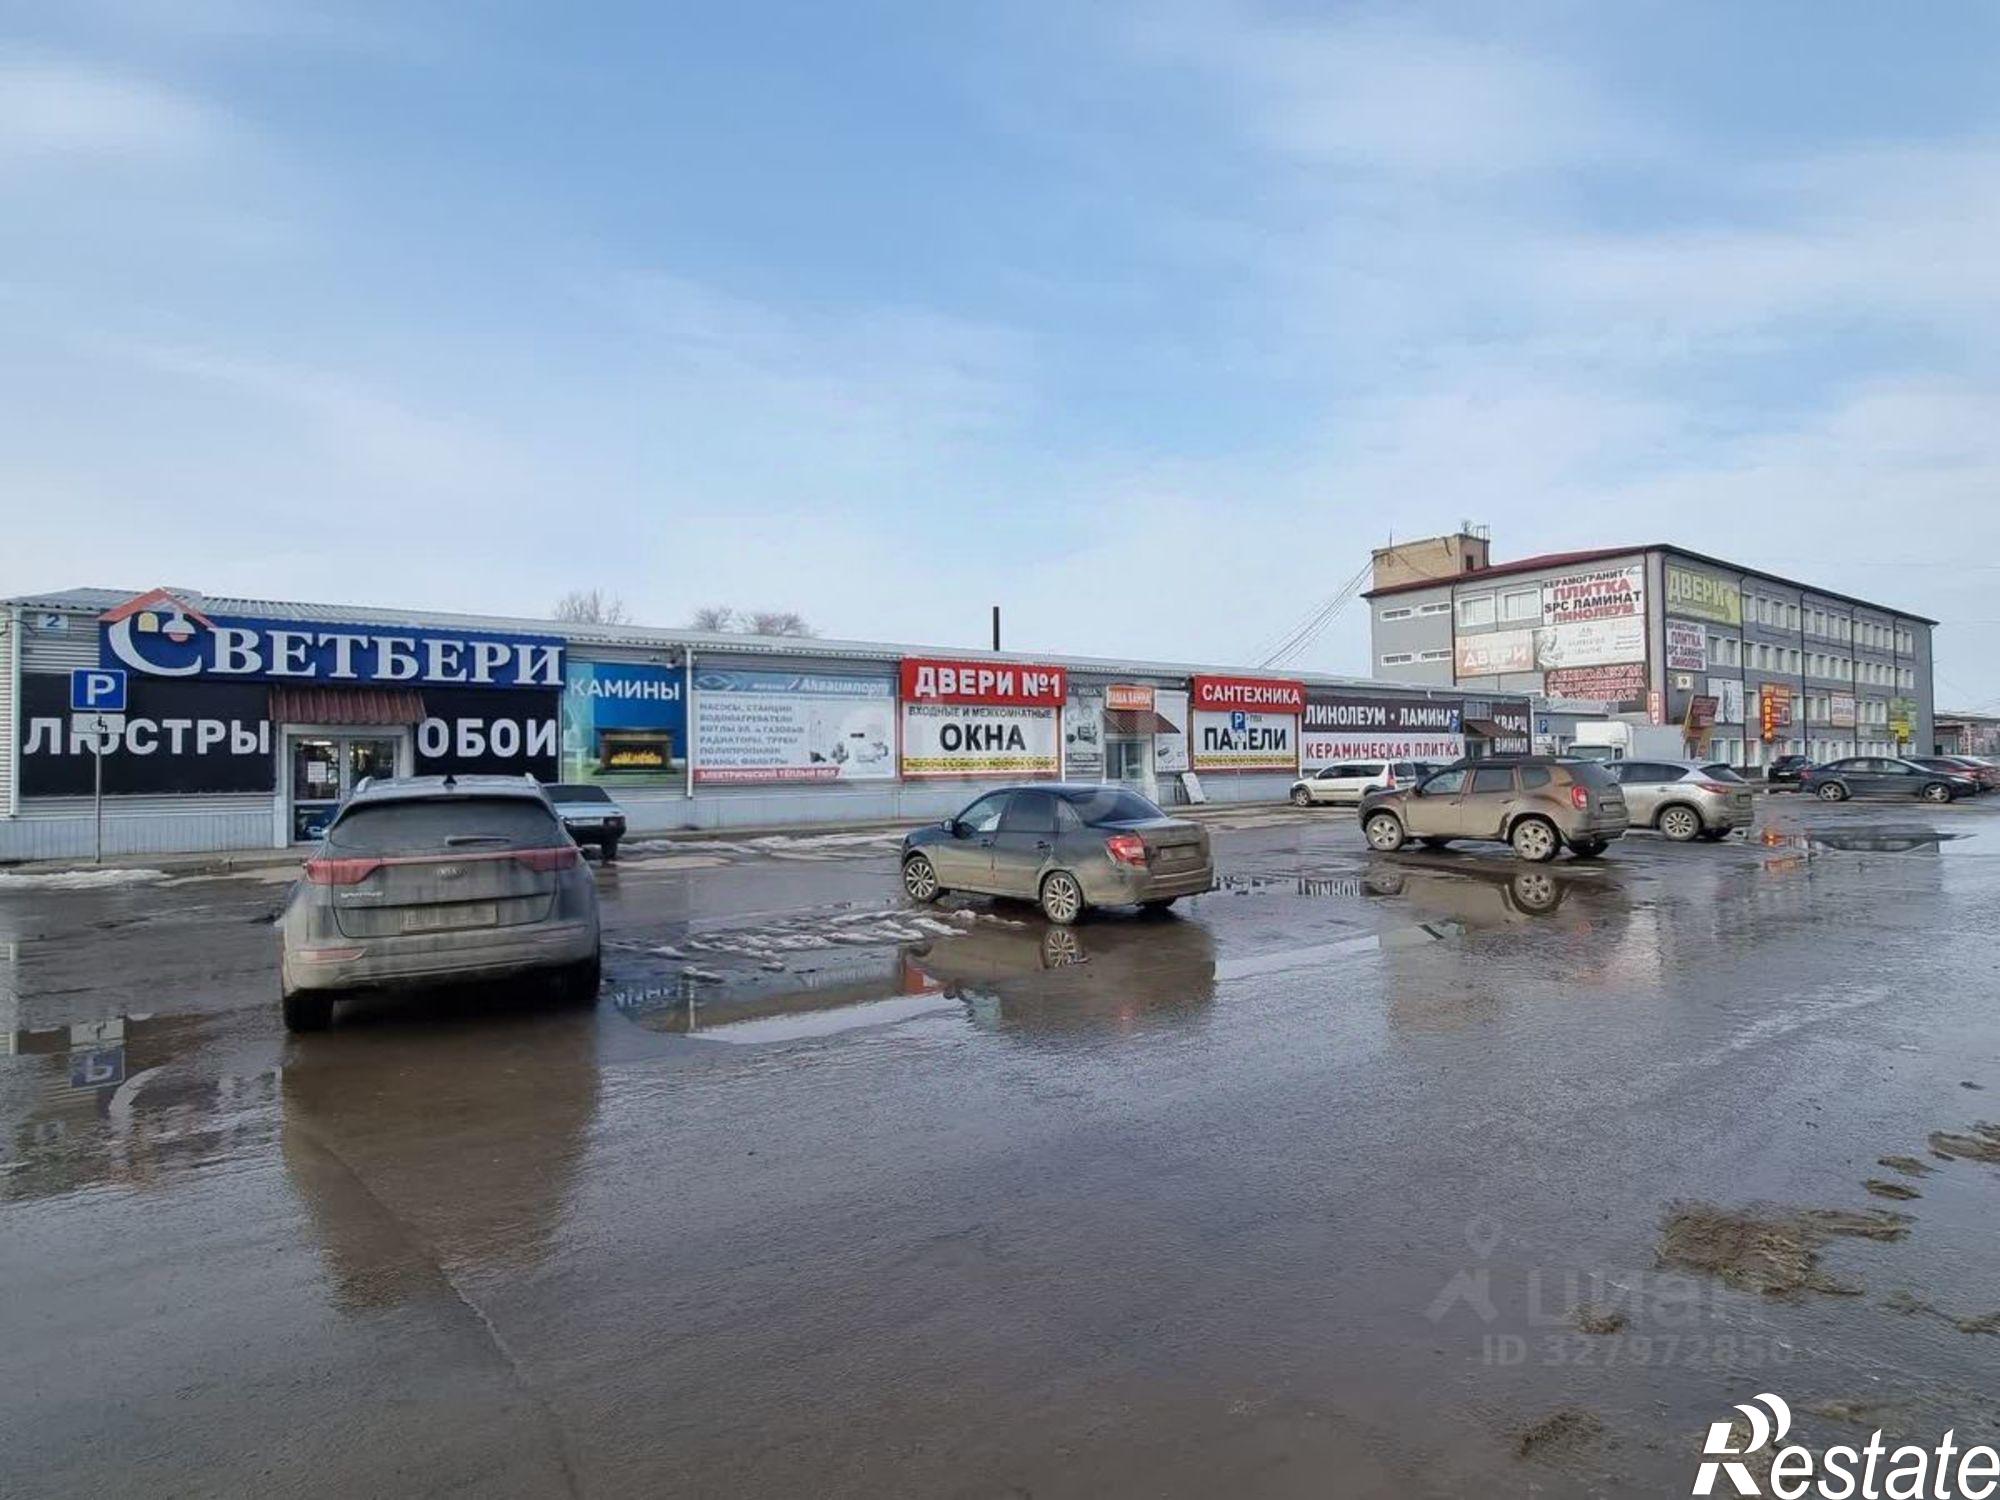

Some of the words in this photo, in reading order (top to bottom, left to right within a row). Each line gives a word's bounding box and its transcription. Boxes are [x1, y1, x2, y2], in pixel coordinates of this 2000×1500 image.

[1553, 578, 1632, 600] ПЛИТКА
[1667, 568, 1725, 607] ДВЕРИ
[1544, 600, 1569, 614] SPC
[1573, 590, 1642, 610] ЛАМИНАТ
[108, 612, 565, 687] СВЕТБЕРИ
[1464, 645, 1528, 668] ДВРИ
[570, 678, 680, 701] КАМИНЫ
[914, 666, 1014, 698] ДВЕРИ
[1022, 671, 1061, 698] №1
[1202, 684, 1301, 704] САНТЕХНИКА
[909, 706, 960, 717] ВХОДНЫЕ
[962, 707, 970, 717] И
[972, 707, 1053, 718] МЕЖКОМНАТНЫЕ
[1304, 704, 1386, 726] ЛИНОЛЕУМ
[23, 717, 270, 755] ЛЮСТРЫ
[417, 717, 557, 758] ОБОИ
[939, 722, 1027, 752] ОКНА
[1306, 742, 1411, 759] КЕРАМИЧЕСКАЯ
[1414, 742, 1460, 758] ПЛИТКА
